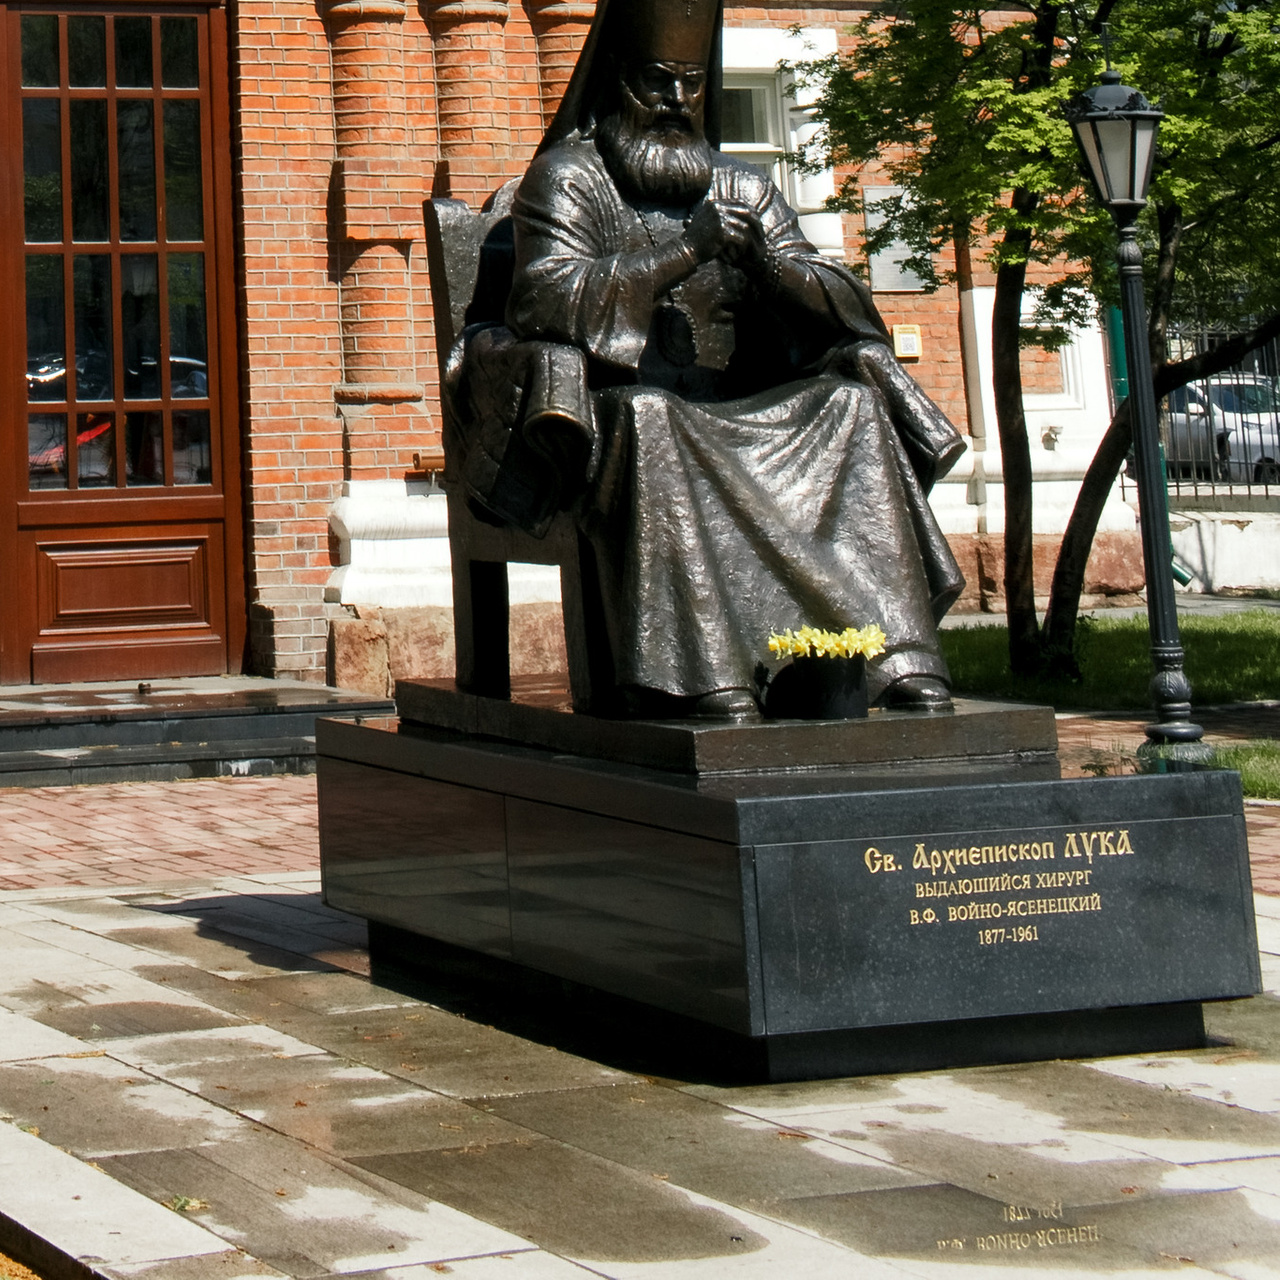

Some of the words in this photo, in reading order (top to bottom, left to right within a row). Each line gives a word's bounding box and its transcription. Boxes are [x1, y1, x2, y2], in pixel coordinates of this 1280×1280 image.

[864, 847, 903, 874] Св.
[1064, 830, 1135, 865] ЛУКА
[1035, 870, 1093, 889] ХИРУРГ
[910, 908, 940, 925] В.Ф.
[948, 893, 1102, 922] ВОЙНО-ЯСЕНЕЦКИЙ
[978, 925, 1039, 945] 1877-1961
